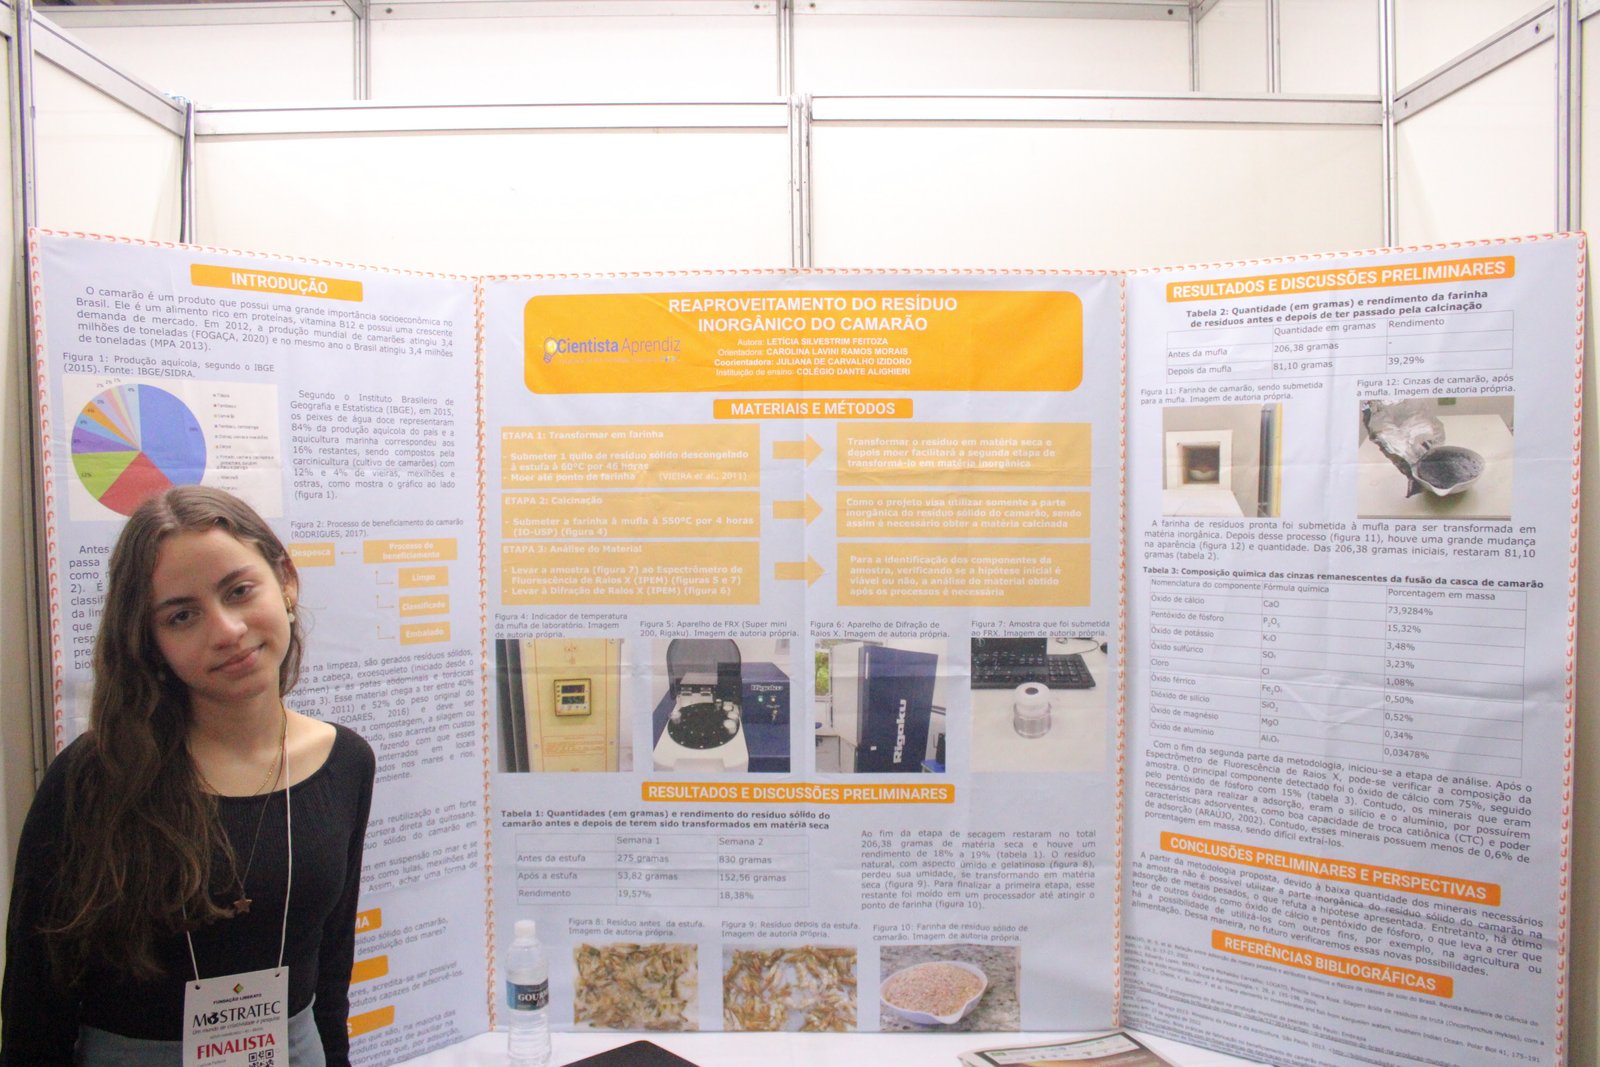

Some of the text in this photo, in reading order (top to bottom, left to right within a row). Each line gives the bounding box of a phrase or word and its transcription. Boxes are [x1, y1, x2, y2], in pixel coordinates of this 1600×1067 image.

[231, 273, 328, 294] INTRODUÇÃO
[1173, 261, 1505, 297] RESULTADOS E DISCUSSÕES PRELIMINARES
[668, 297, 957, 311] REAPROVEITAMENTO DO RESÍDUO
[1186, 308, 1217, 317] Tabela
[1231, 304, 1286, 316] Quantidade
[1289, 303, 1309, 312] (em
[1311, 298, 1354, 311] gramas)
[1366, 294, 1428, 305] rendimento
[1430, 292, 1444, 301] da
[1447, 290, 1488, 300] farinha
[698, 314, 927, 331] INORGÂNICO DO CAMARÃO
[1388, 318, 1445, 328] Rendimento
[1273, 325, 1323, 336] Quantidade
[1342, 322, 1376, 332] gramas
[78, 333, 211, 352] de toneladas (MPA 2013).
[556, 338, 680, 353] Cientista Aprendiz
[766, 337, 799, 345] LETÍCIA
[1273, 342, 1339, 352] 206,38 gramas
[62, 351, 94, 362] Figura
[99, 354, 108, 362] 1:
[113, 354, 157, 366] Produção
[204, 361, 241, 370] segundo
[253, 363, 274, 372] IBGE
[1272, 360, 1333, 371] 81,10 gramas
[1388, 355, 1424, 365] 39,29%
[63, 362, 195, 378] (2015). Fonte: IBGE/SIDRA.
[796, 367, 835, 375] COLÉGIO
[1167, 367, 1194, 376] Depois
[298, 389, 335, 400] Segundo
[358, 393, 392, 403] Instituto
[401, 395, 437, 405] Brasileiro
[444, 397, 454, 406] de
[730, 401, 895, 414] MATERIAIS E MÉTODOS
[294, 490, 323, 500] (figura
[78, 545, 110, 554] Antes
[68, 558, 100, 569] passa
[68, 571, 99, 580] como
[1142, 566, 1169, 574] Tabela
[1180, 567, 1230, 576] Composição
[1268, 570, 1284, 578] das
[1316, 573, 1387, 582] remanescentes
[1389, 575, 1402, 583] da
[1404, 575, 1432, 584] fusão
[1434, 576, 1447, 584] da
[1480, 578, 1494, 586] de
[1496, 579, 1544, 588] camarão
[1387, 588, 1445, 598] Porcentagem
[1465, 592, 1496, 600] massa
[1388, 605, 1433, 615] 73,9284%
[1387, 623, 1421, 633] 15,32%
[1386, 641, 1415, 651] 3,48%
[1386, 659, 1415, 669] 3,23%
[1386, 677, 1414, 687] 1,08%
[1384, 694, 1414, 704] 0,50%
[1384, 712, 1413, 722] 0,52%
[893, 699, 906, 764] Rigaku
[1383, 729, 1413, 740] 0,34%
[1383, 747, 1430, 759] 0,03478%
[648, 785, 947, 800] RESULTADOS E DISCUSSÕES PRELIMINARES
[546, 809, 605, 818] Quantidades
[608, 809, 627, 818] (em
[629, 810, 668, 818] gramas)
[789, 810, 816, 818] sólido
[818, 812, 830, 820] do
[616, 836, 660, 845] Semana 1
[718, 837, 763, 846] Semana 2
[544, 854, 556, 862] da
[558, 853, 586, 862] estufa
[617, 853, 669, 863] 275 gramas
[718, 855, 772, 865] 830 gramas
[1170, 837, 1486, 899] CONCLUSÕES PRELIMINARES E PERSPECTIVAS
[518, 889, 571, 897] Rendimento
[618, 889, 652, 898] 19,57%
[719, 891, 754, 899] 18,38%
[1224, 937, 1435, 990] REFERÊNCIAS BIBLIOGRÁFICAS
[192, 1001, 281, 1028] MOSTRATEC
[196, 1033, 276, 1060] FINALISTA
